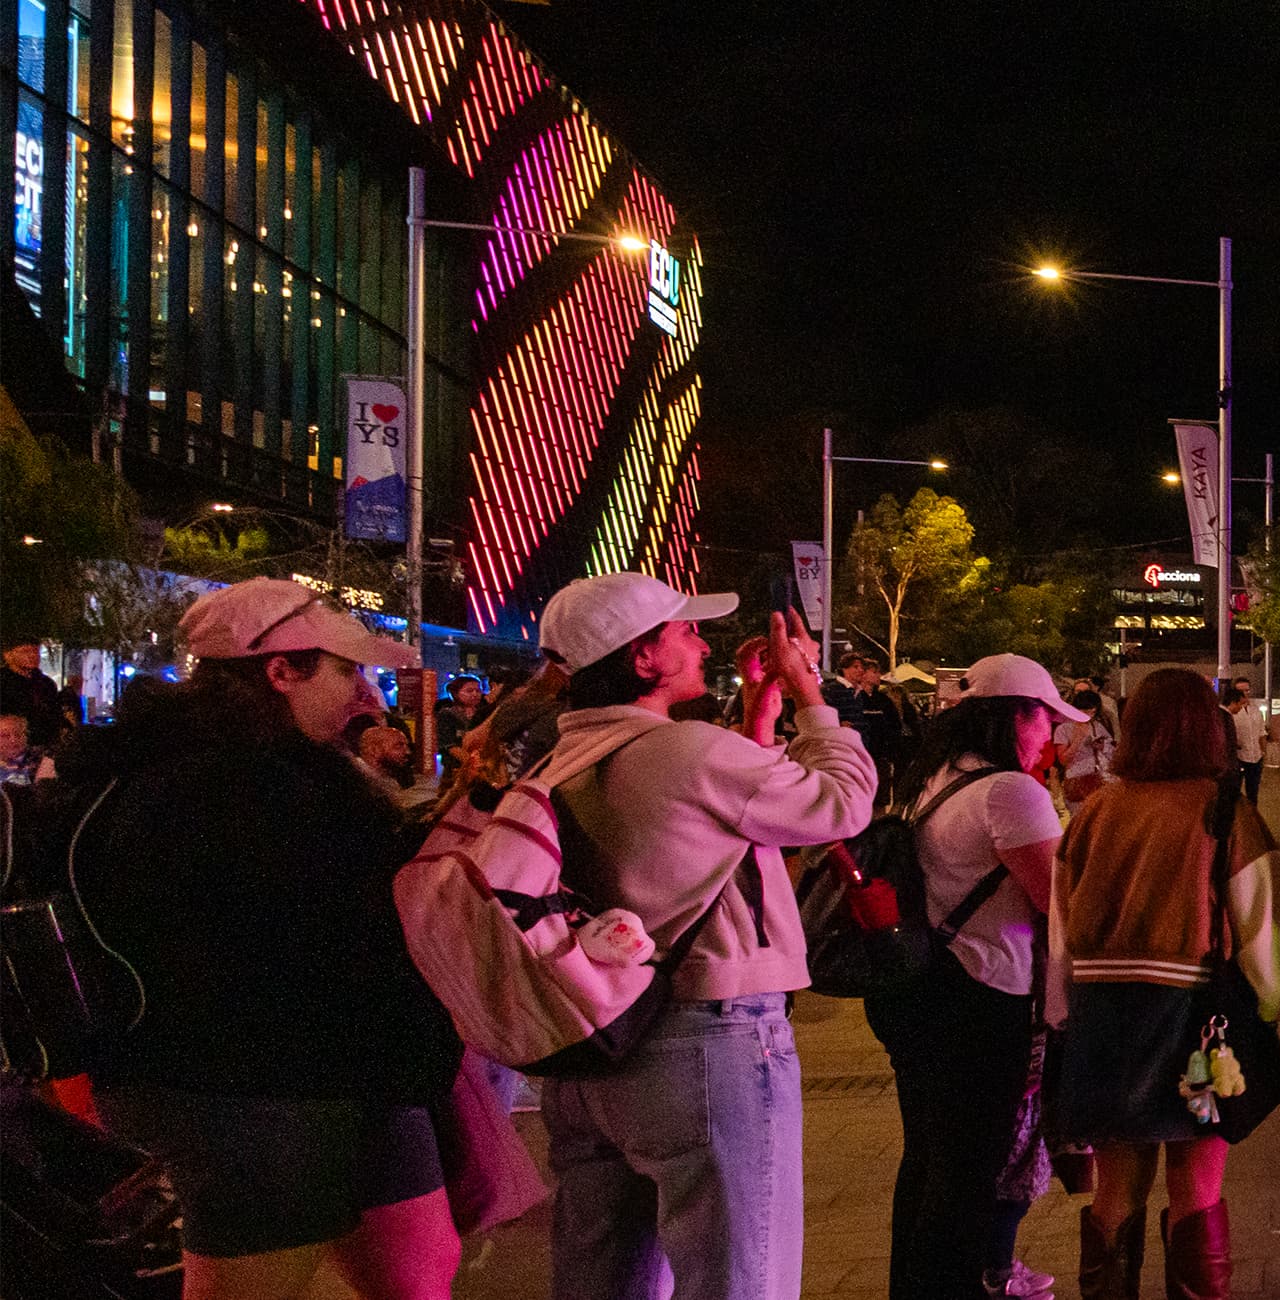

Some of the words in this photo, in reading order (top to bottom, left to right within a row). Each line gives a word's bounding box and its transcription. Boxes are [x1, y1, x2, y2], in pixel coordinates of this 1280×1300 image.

[16, 131, 44, 176] EC
[650, 239, 680, 306] ECU
[356, 402, 369, 422] I
[354, 424, 399, 447] YS
[1192, 447, 1207, 500] KAYA
[1158, 570, 1200, 582] acciona
